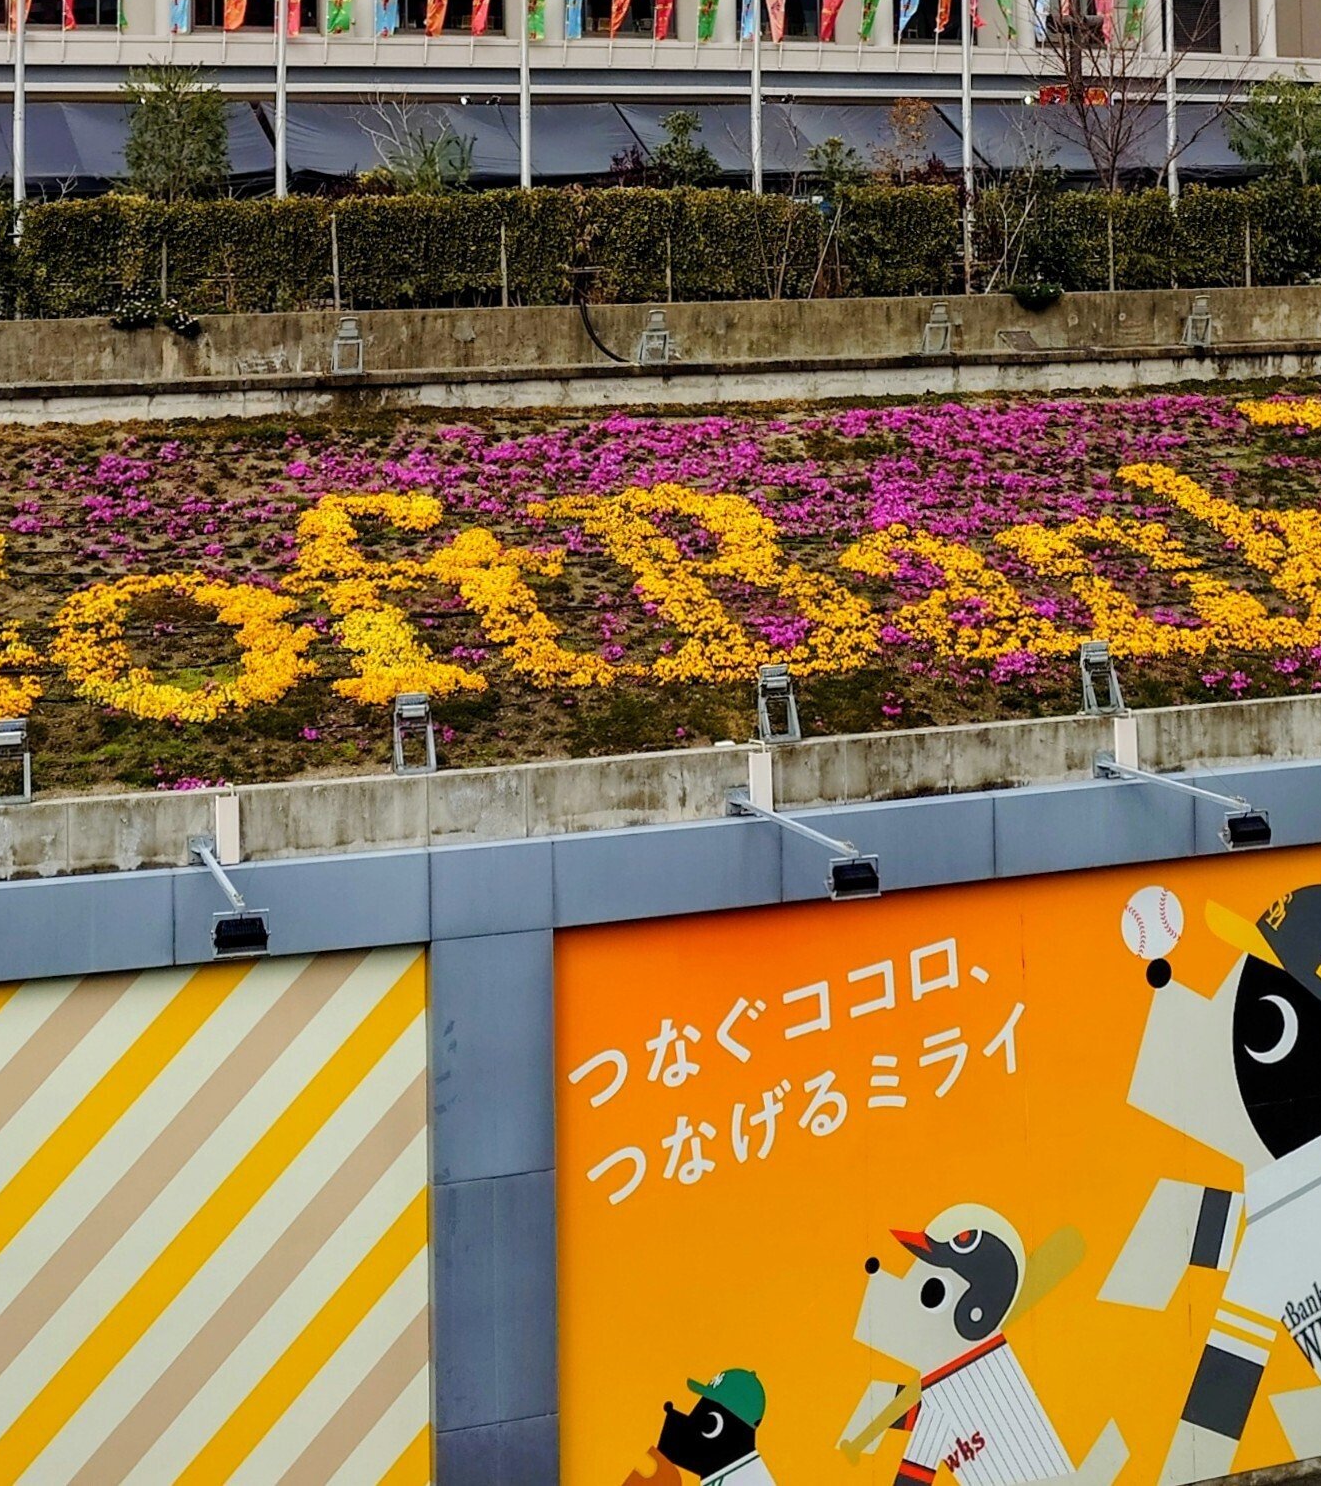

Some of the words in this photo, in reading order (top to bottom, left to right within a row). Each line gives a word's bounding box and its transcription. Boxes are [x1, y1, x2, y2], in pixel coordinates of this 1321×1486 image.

[568, 936, 990, 1108] つなぐココロ、
[586, 1002, 1025, 1205] つなげるミライ
